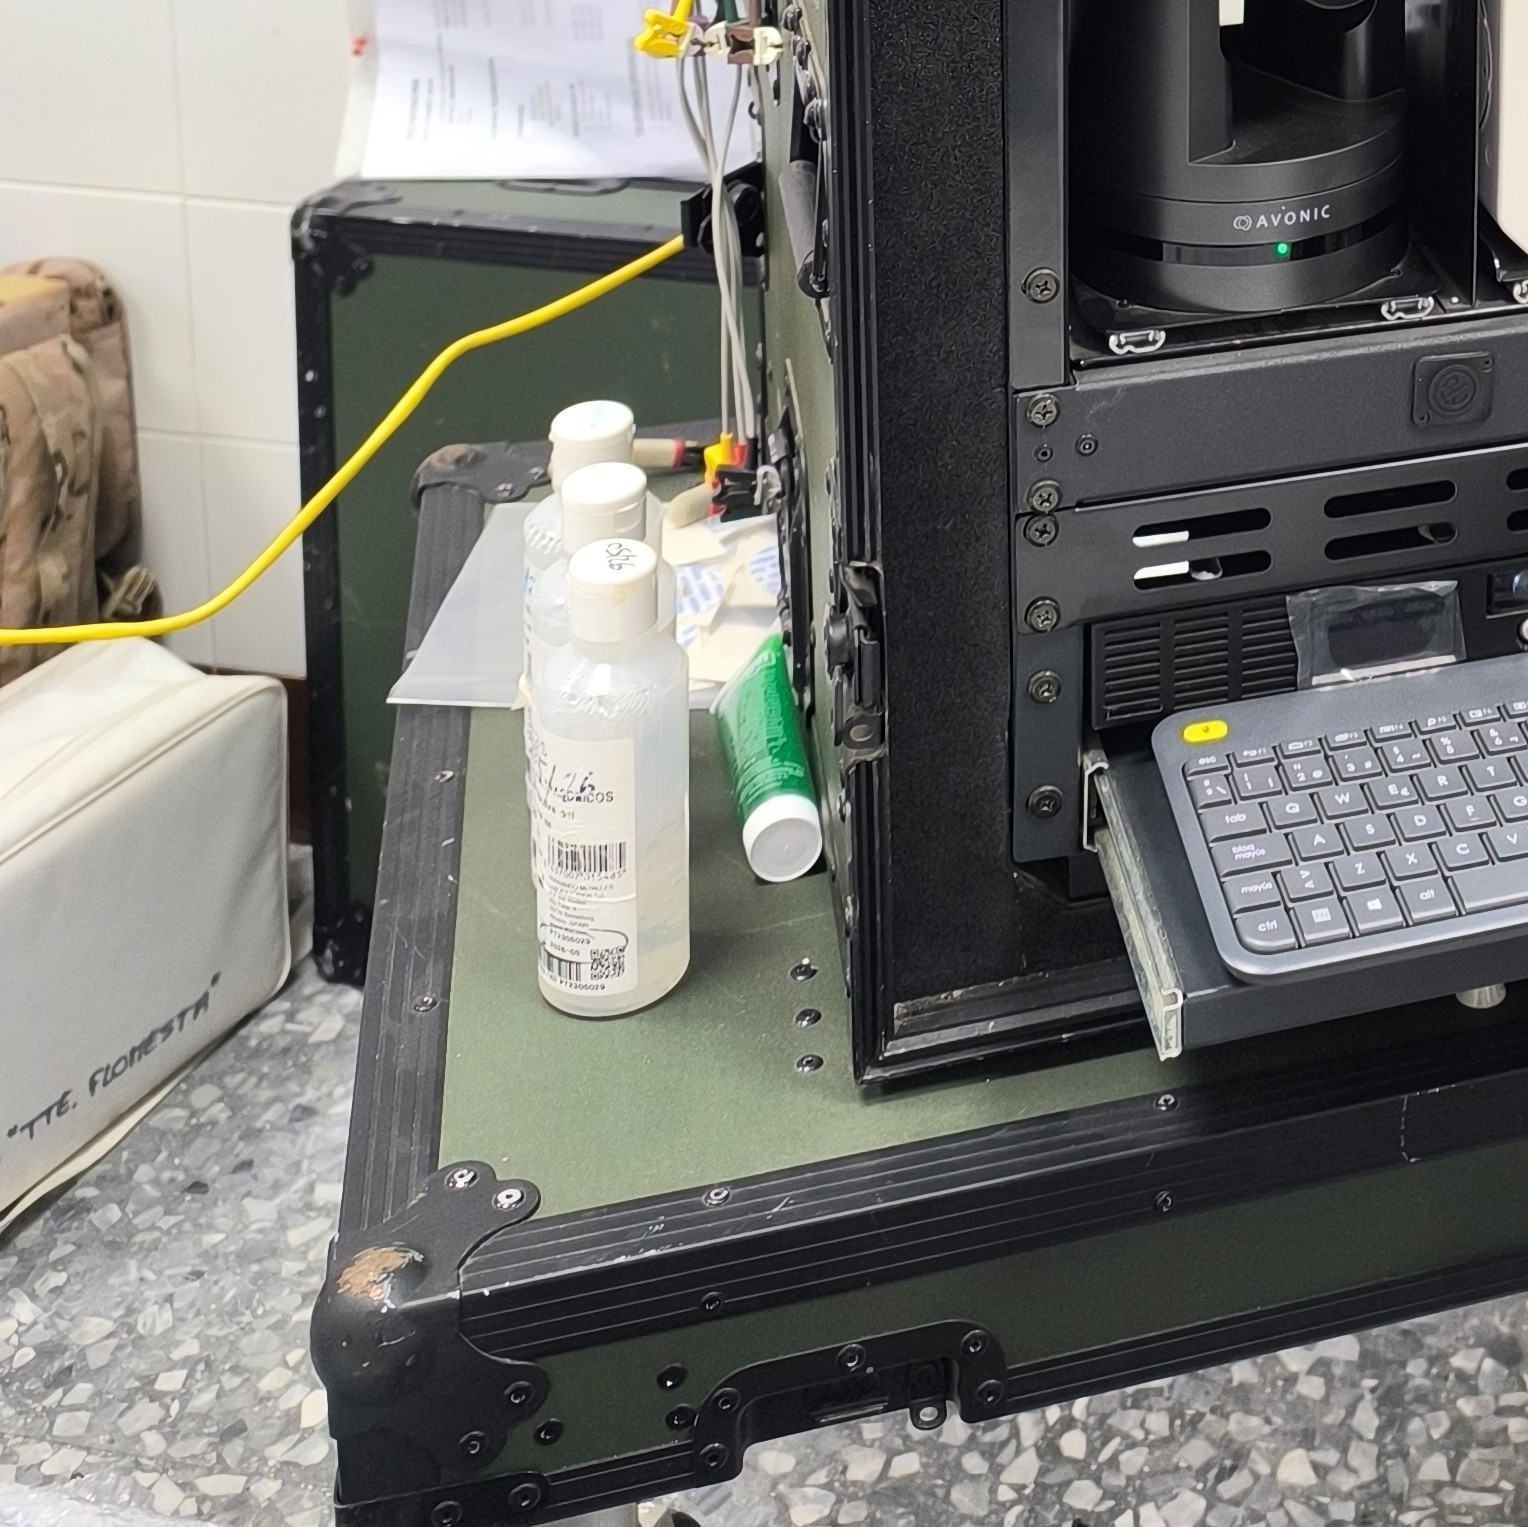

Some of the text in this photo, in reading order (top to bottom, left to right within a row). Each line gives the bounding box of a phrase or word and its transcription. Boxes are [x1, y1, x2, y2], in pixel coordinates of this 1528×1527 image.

[1256, 205, 1330, 229] AVONIC
[1437, 775, 1448, 786] R
[1388, 784, 1399, 795] E
[1335, 792, 1350, 804] W
[1513, 795, 1528, 807] G
[1465, 804, 1475, 816] F
[1225, 812, 1247, 824] tab
[1413, 815, 1427, 826] D
[1365, 823, 1376, 835] S
[1313, 833, 1326, 846] A
[1506, 832, 1518, 845] V
[1455, 843, 1470, 855] C
[1405, 852, 1418, 865] X
[1355, 862, 1366, 875] Z
[1419, 889, 1435, 901] alt
[1258, 919, 1278, 932] ctrl
